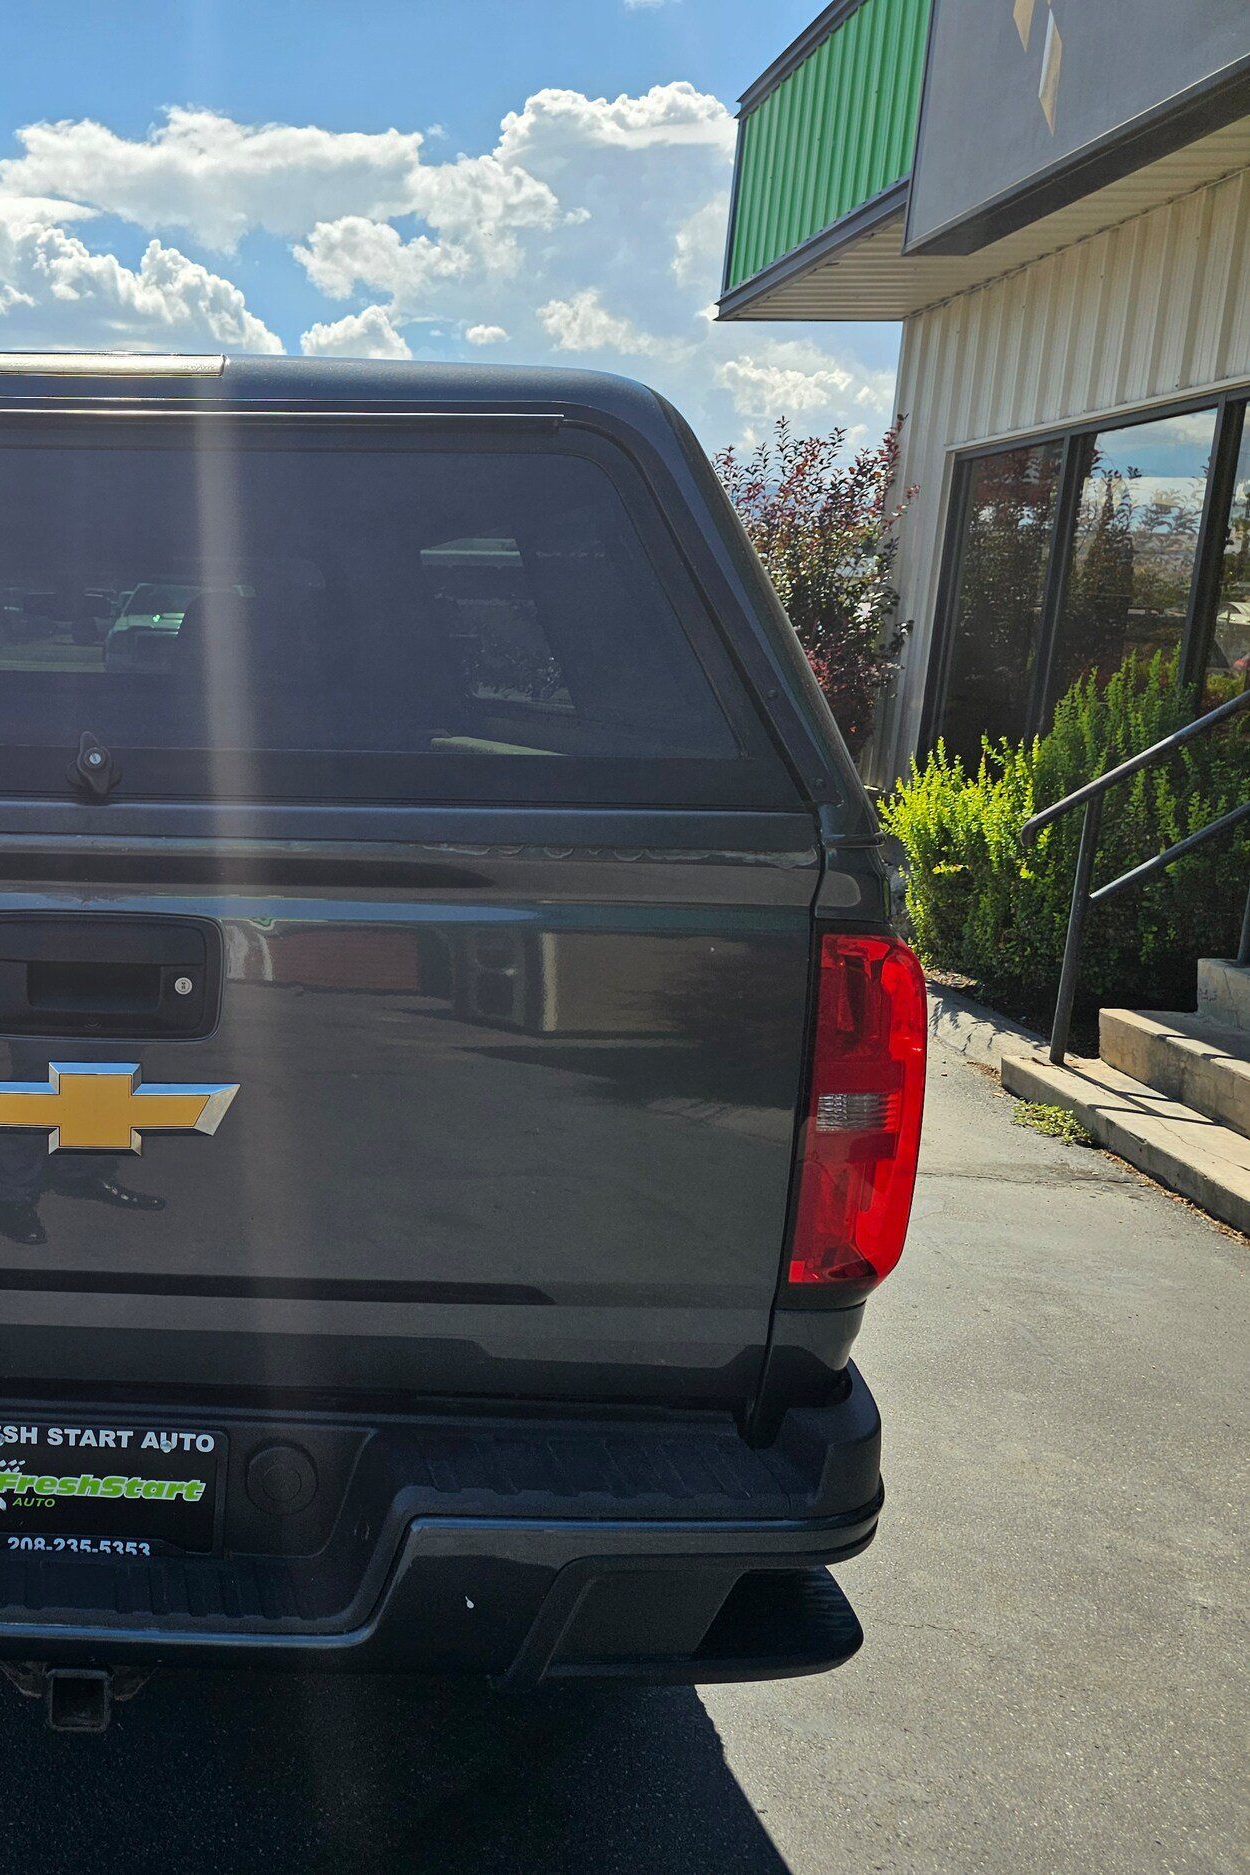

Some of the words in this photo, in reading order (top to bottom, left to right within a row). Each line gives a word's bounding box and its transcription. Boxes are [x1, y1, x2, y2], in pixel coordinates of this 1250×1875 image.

[47, 1428, 133, 1448] START
[141, 1431, 215, 1453] AUTO
[12, 1497, 56, 1508] AUTO
[7, 1536, 151, 1556] 208-235-5353
